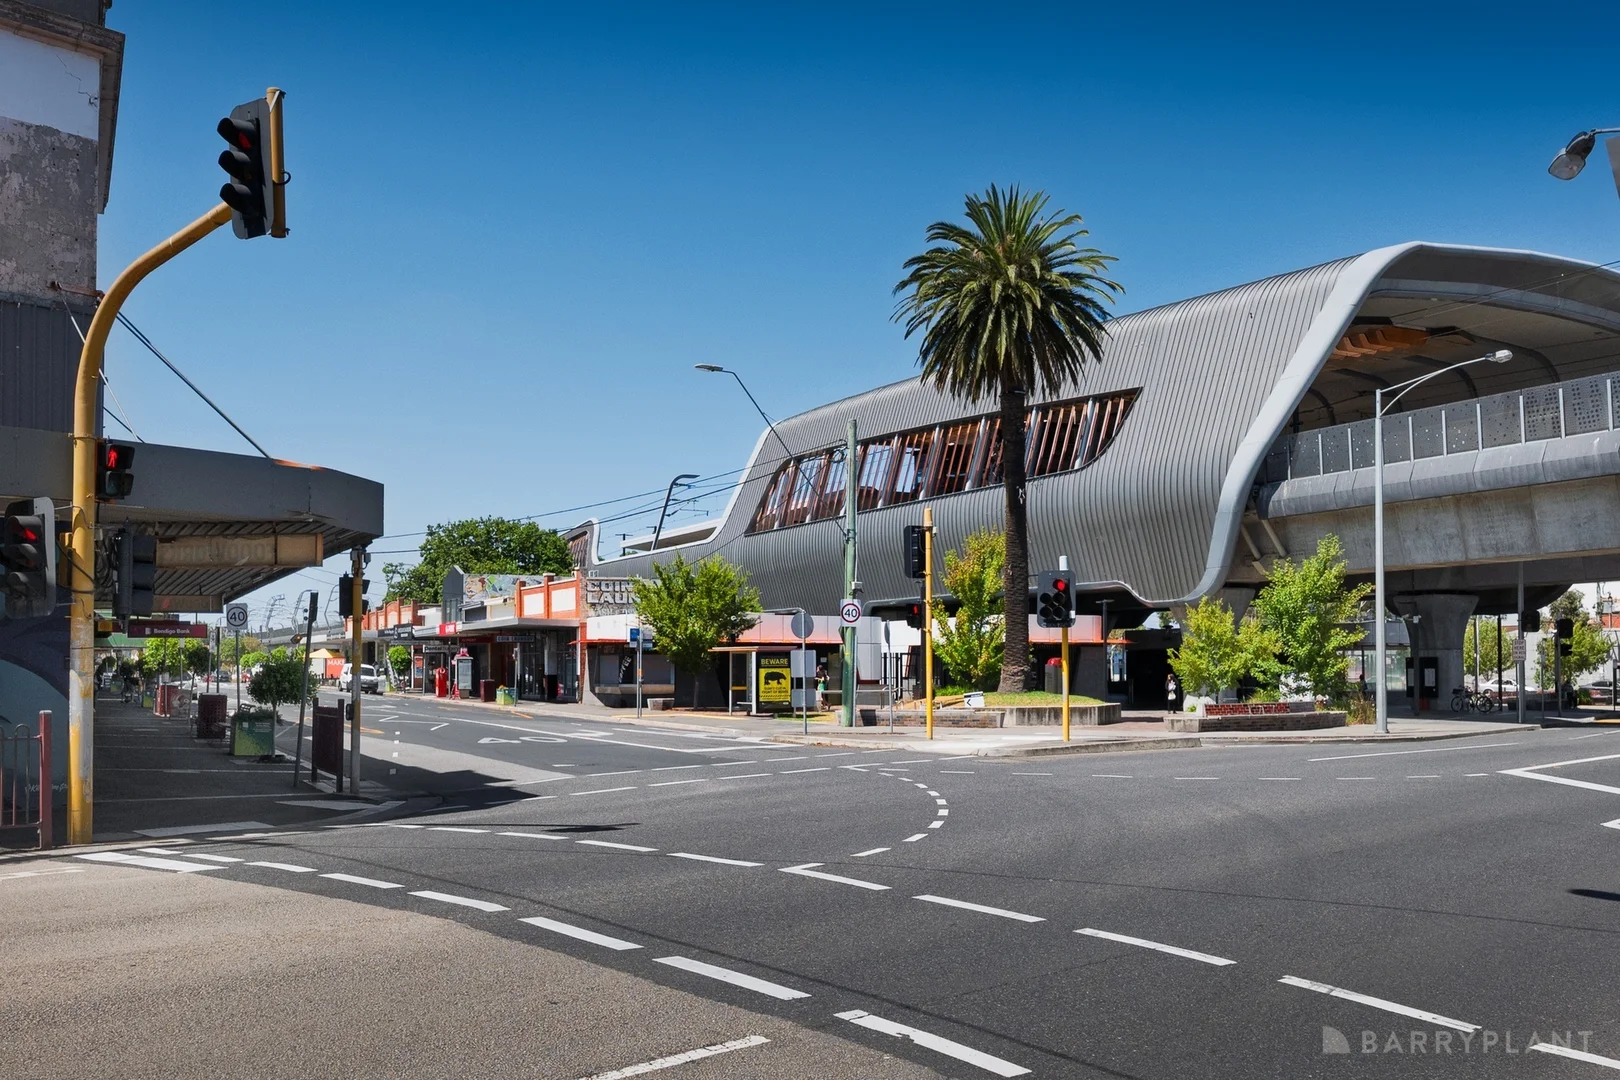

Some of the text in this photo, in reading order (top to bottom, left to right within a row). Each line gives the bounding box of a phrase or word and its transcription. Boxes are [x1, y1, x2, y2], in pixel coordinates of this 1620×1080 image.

[586, 581, 635, 592] COIN
[229, 612, 245, 622] 40
[844, 608, 858, 618] 40
